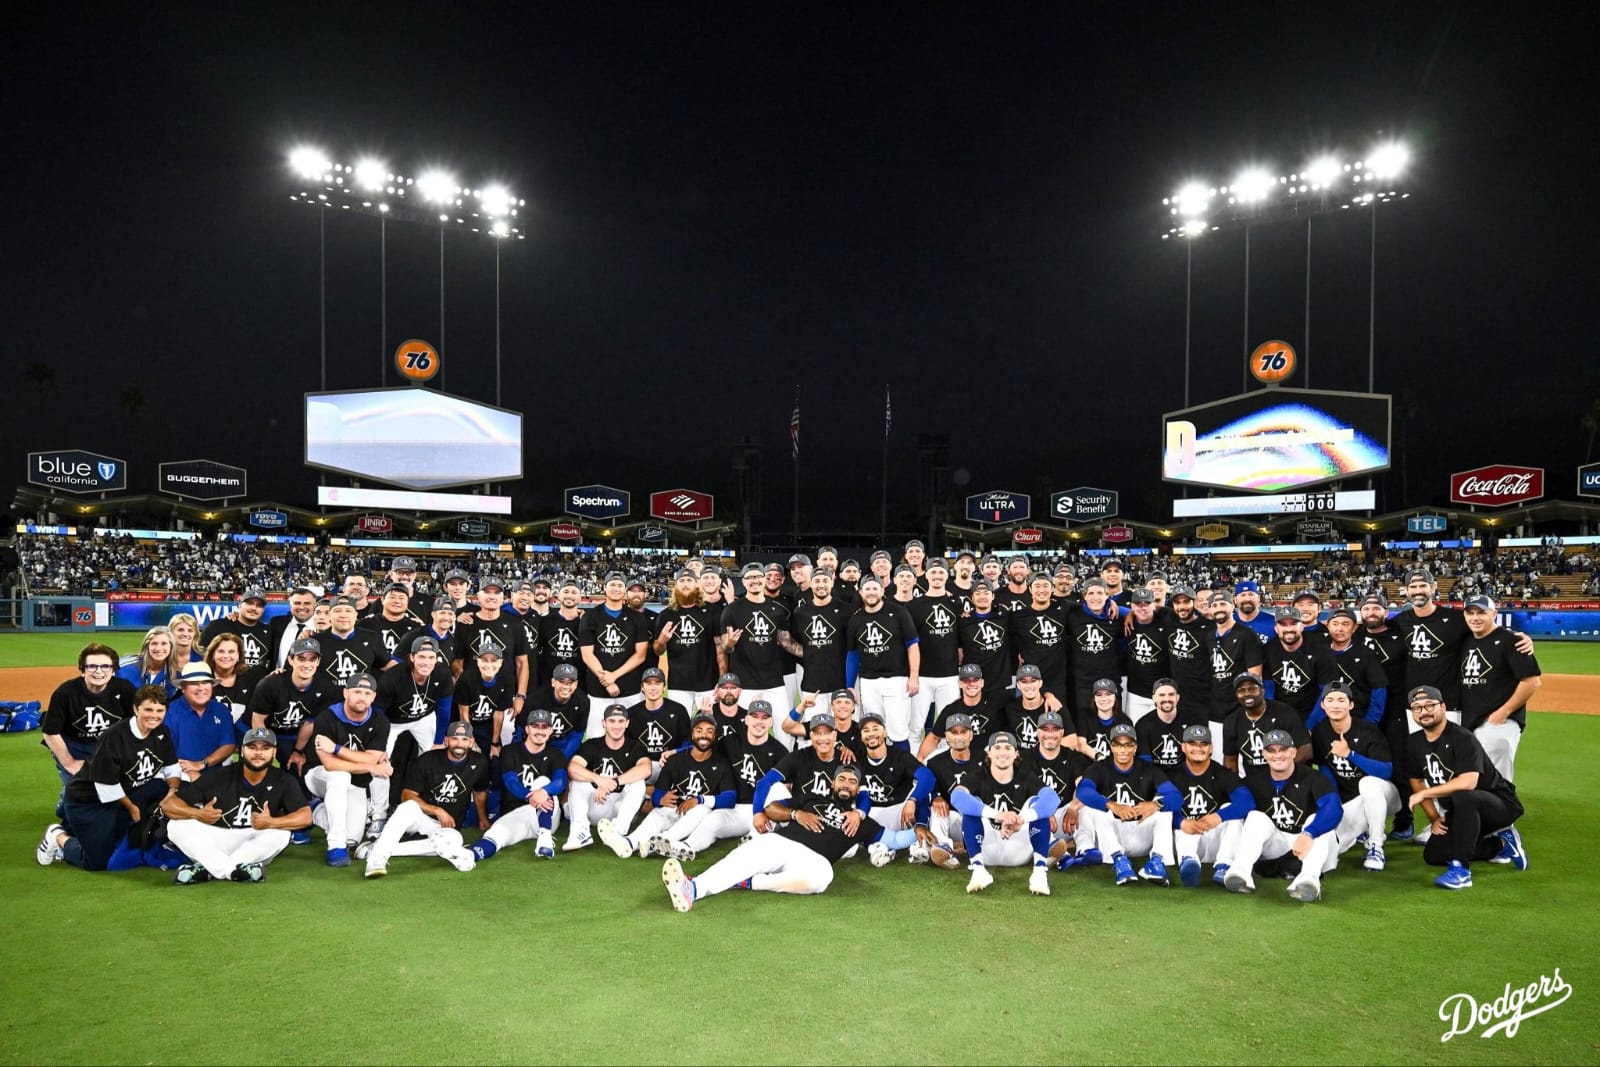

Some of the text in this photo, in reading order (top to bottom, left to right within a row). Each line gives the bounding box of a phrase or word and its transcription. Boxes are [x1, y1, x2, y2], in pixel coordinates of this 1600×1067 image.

[404, 351, 432, 371] 76
[1260, 350, 1288, 372] 76
[38, 456, 92, 476] blue
[47, 476, 98, 486] california
[1459, 473, 1535, 497] Coca-Cola
[572, 495, 620, 507] Spectrum
[980, 500, 1015, 510] ULTRA
[1076, 495, 1111, 505] Security
[1076, 505, 1106, 513] Benefit
[365, 519, 387, 528] JINRO
[1412, 519, 1442, 530] TEL
[76, 612, 91, 622] 76
[680, 616, 695, 637] LA
[752, 612, 768, 635] LA
[811, 616, 826, 638] LA
[932, 605, 950, 627] LA
[1037, 616, 1057, 638] LA
[557, 629, 573, 651] LA
[605, 625, 620, 646] LA
[866, 623, 882, 645] LA
[978, 622, 999, 644] LA
[1086, 624, 1103, 646] LA
[1174, 629, 1190, 650] LA
[1411, 625, 1431, 651] LA
[242, 634, 260, 657] LA
[1135, 634, 1152, 656] LA
[336, 651, 357, 677] LA
[1465, 649, 1480, 676] LA
[1281, 661, 1301, 687] LA
[475, 695, 492, 717] LA
[85, 707, 110, 732] LA
[647, 722, 663, 745] LA
[1161, 735, 1177, 758] LA
[137, 751, 154, 780] LA
[1188, 786, 1207, 815] LA
[1272, 797, 1294, 825] LA
